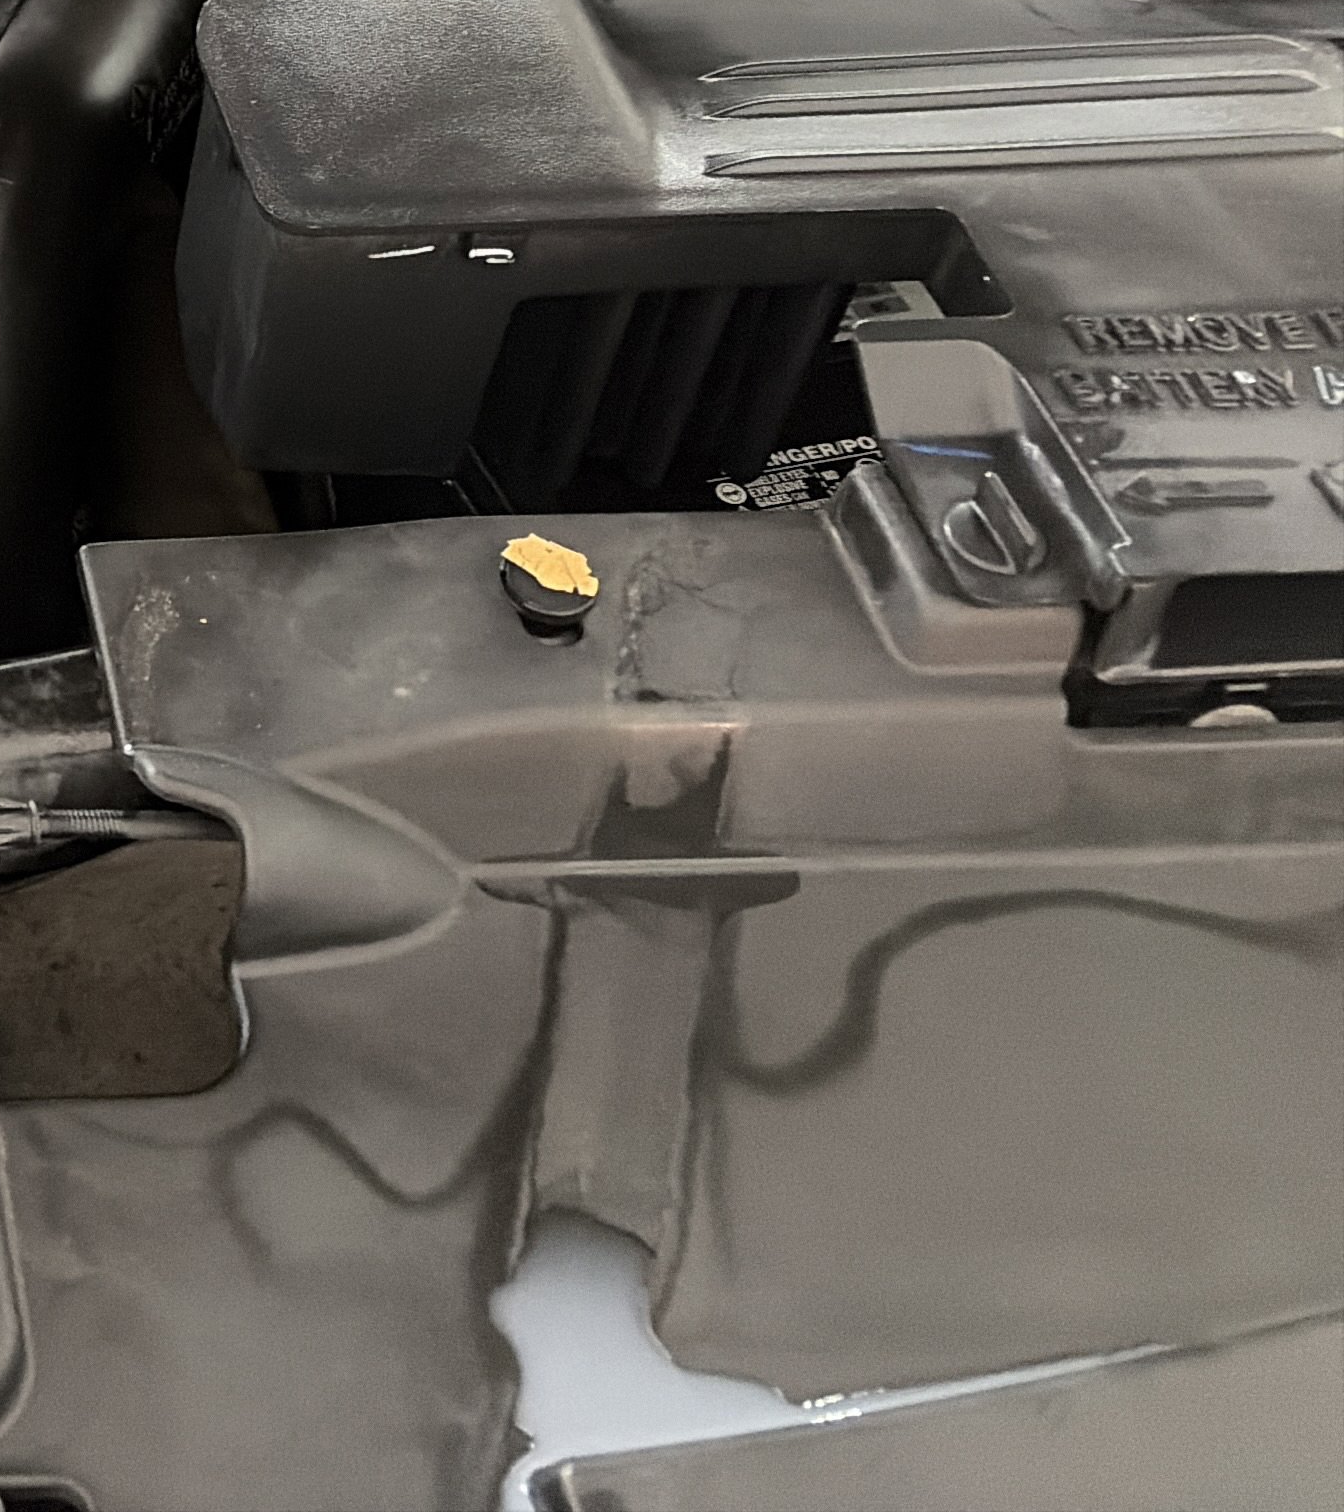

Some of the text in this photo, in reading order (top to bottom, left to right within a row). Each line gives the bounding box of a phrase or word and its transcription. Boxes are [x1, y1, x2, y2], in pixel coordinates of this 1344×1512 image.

[1062, 310, 1317, 354] REMOVE
[1053, 367, 1300, 410] BATTERY
[749, 479, 810, 499] EXPLOSIVE
[755, 493, 792, 508] GASES
